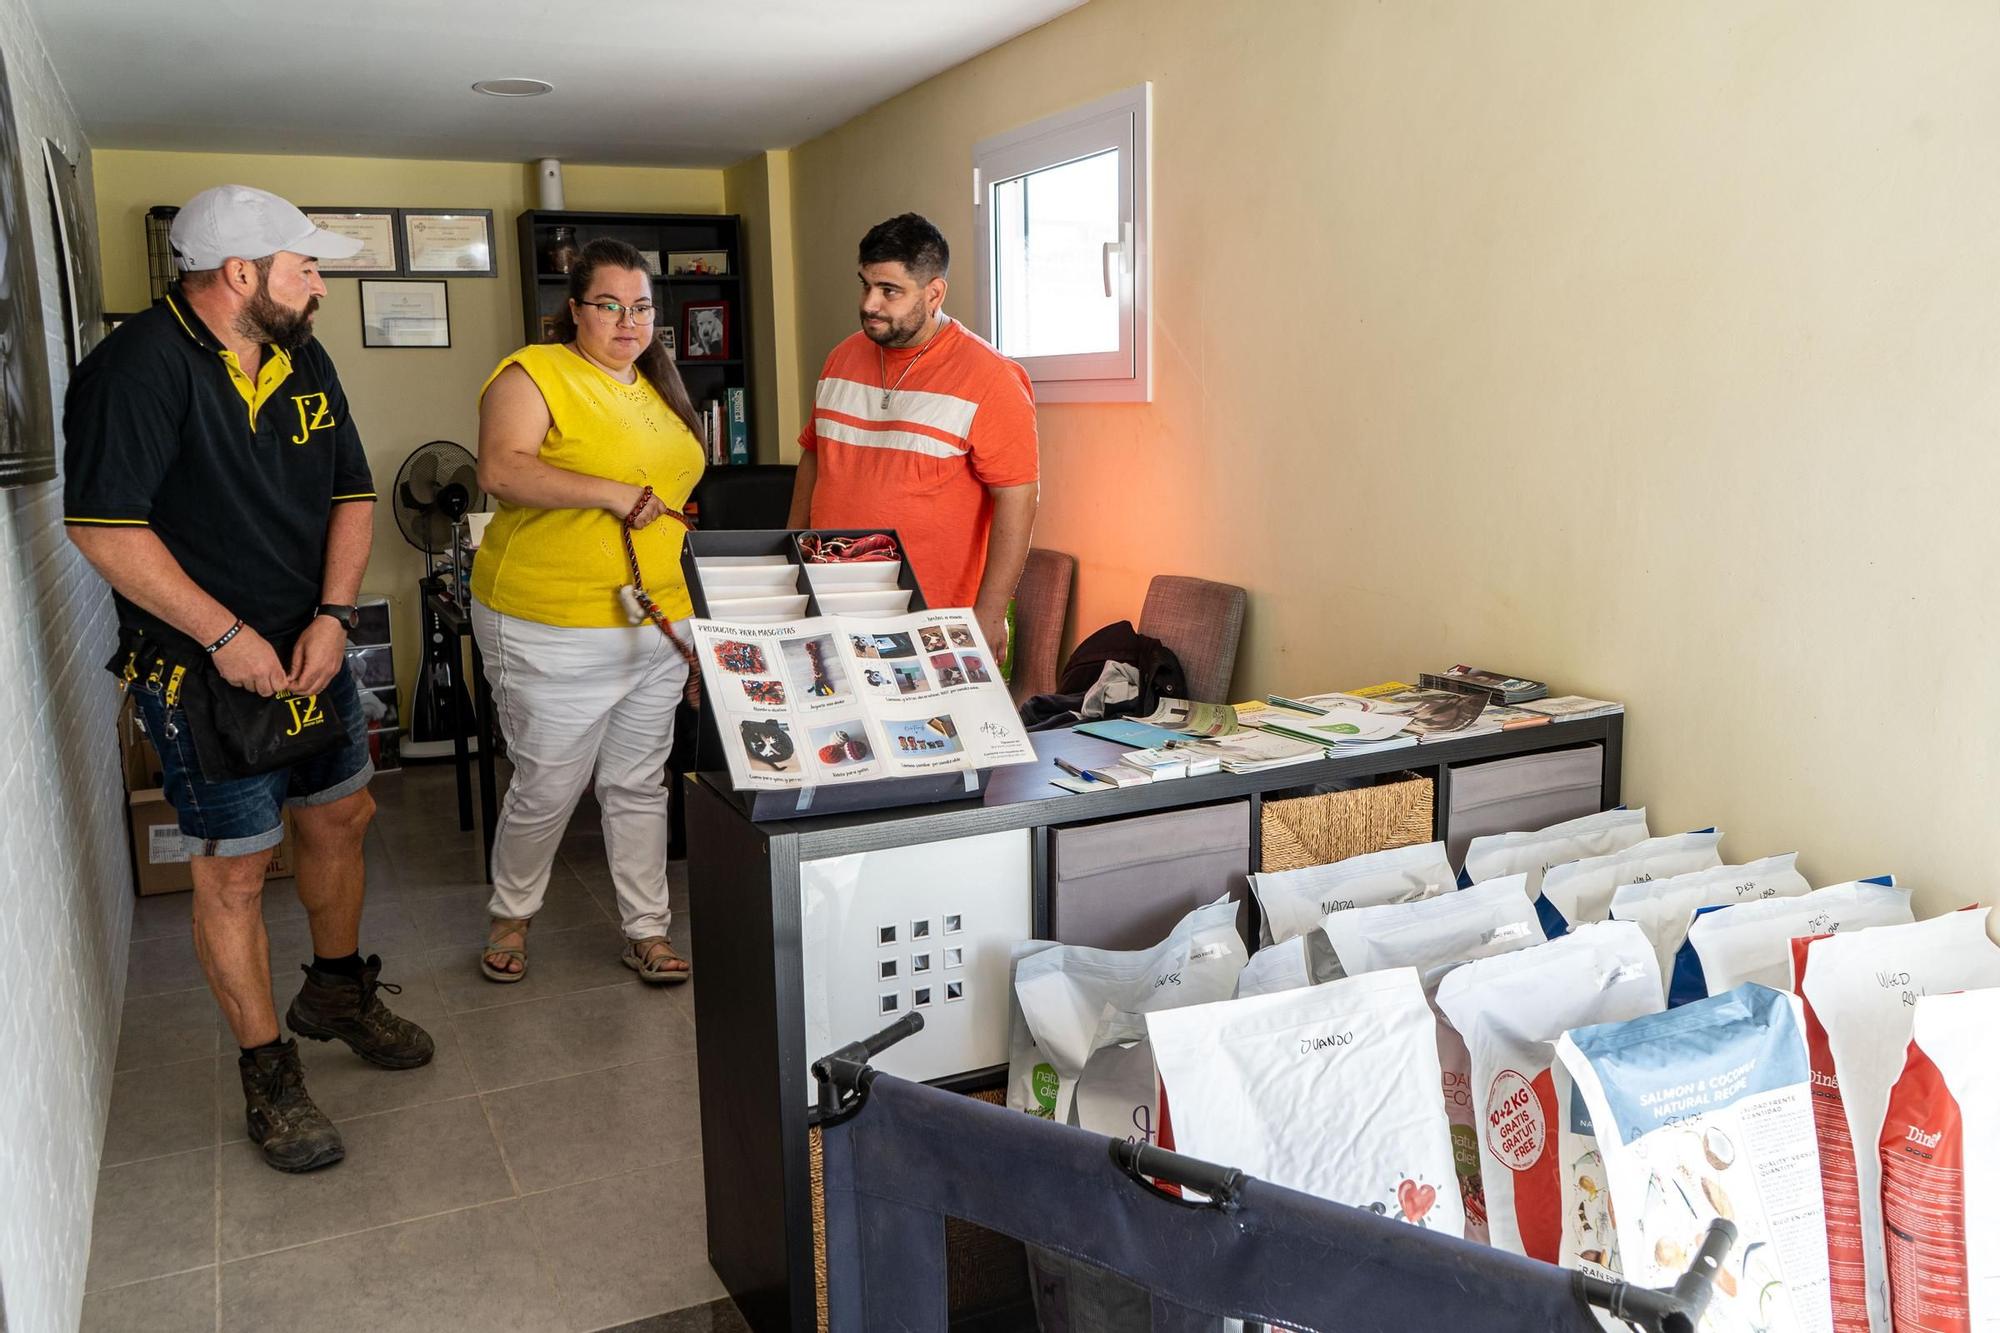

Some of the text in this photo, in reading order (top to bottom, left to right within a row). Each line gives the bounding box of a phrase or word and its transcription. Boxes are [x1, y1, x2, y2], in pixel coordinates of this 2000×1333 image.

[698, 625, 737, 635] PRODUCTOS
[739, 629, 758, 637] PARA
[1810, 1070, 1839, 1089] Ding
[1040, 1085, 1057, 1099] die
[1639, 1083, 1694, 1107] SALMON
[1695, 1079, 1706, 1091] &
[1490, 1101, 1513, 1128] 10+2
[1510, 1088, 1529, 1110] KG
[1653, 1094, 1712, 1119] NATURAL
[1500, 1110, 1530, 1138] GRATIS
[1502, 1120, 1537, 1153] GRATUIT
[1514, 1137, 1536, 1161] FREE
[1578, 1264, 1604, 1279] RAIN
